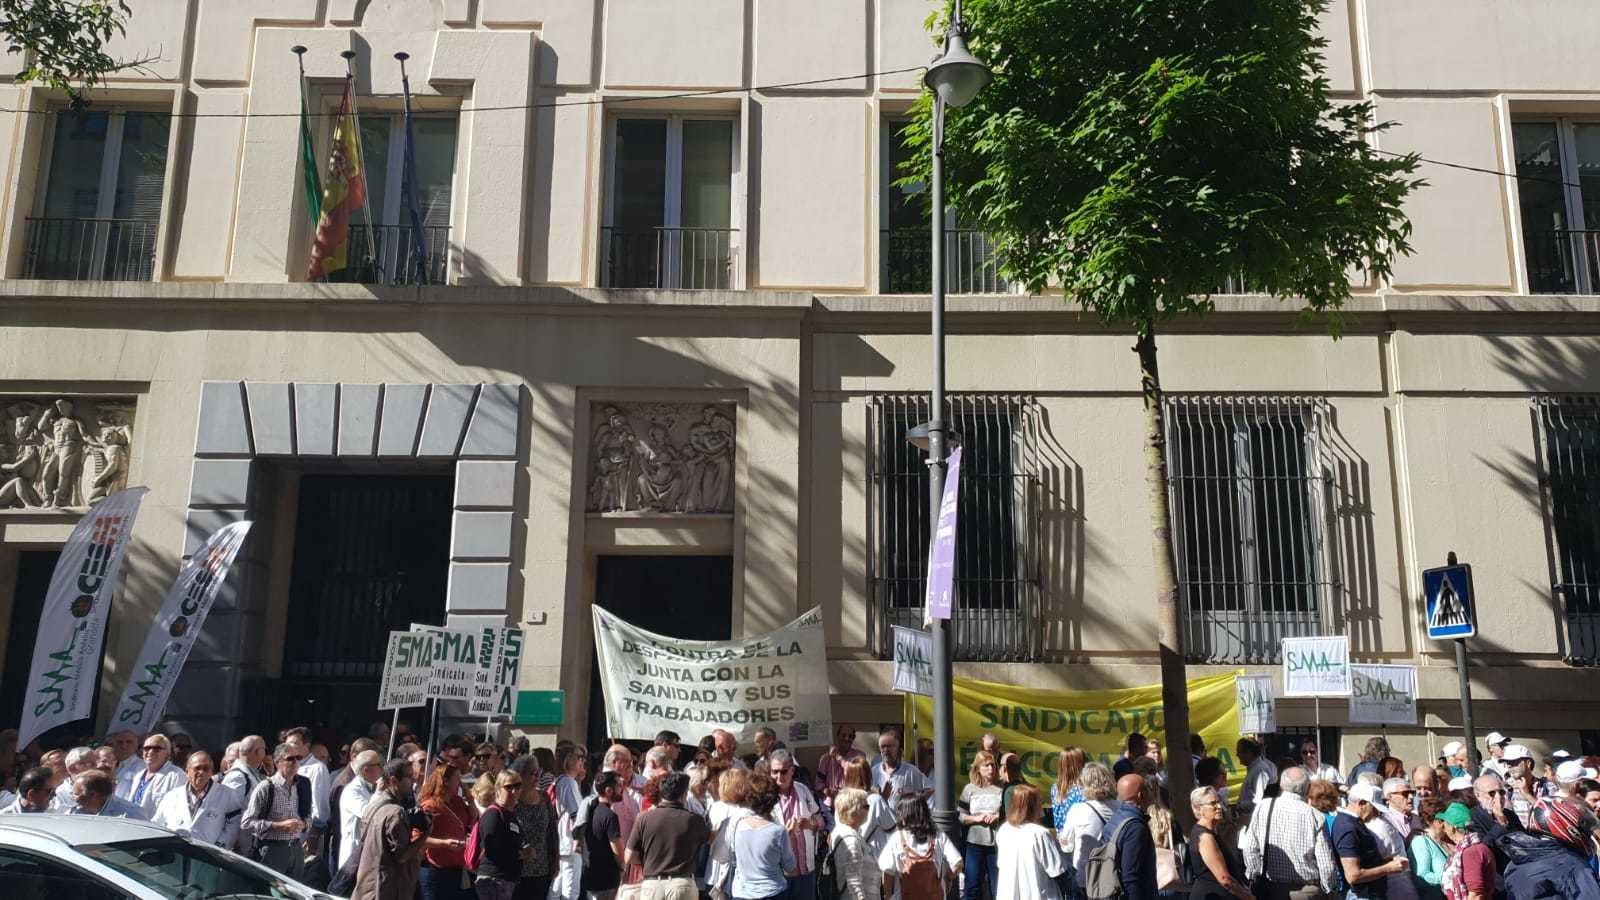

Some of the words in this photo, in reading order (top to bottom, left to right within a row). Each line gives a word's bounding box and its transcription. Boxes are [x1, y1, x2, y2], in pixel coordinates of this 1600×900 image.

[395, 636, 433, 668] SMA
[777, 641, 803, 657] LA
[896, 642, 928, 671] SMA
[1287, 651, 1338, 673] SMA
[33, 640, 77, 717] SMA
[497, 629, 523, 714] SMA
[637, 662, 694, 682] JUNTA
[700, 666, 750, 682] CON
[758, 665, 785, 679] LA
[120, 655, 168, 725] SMA
[628, 680, 718, 703] SANIDAD
[725, 688, 738, 702] Y
[745, 684, 791, 701] SUS
[1239, 687, 1268, 712] SMA
[1352, 677, 1404, 701] SMA
[623, 697, 795, 724] TRABAJADORES
[979, 703, 1165, 735] SINDICATO
